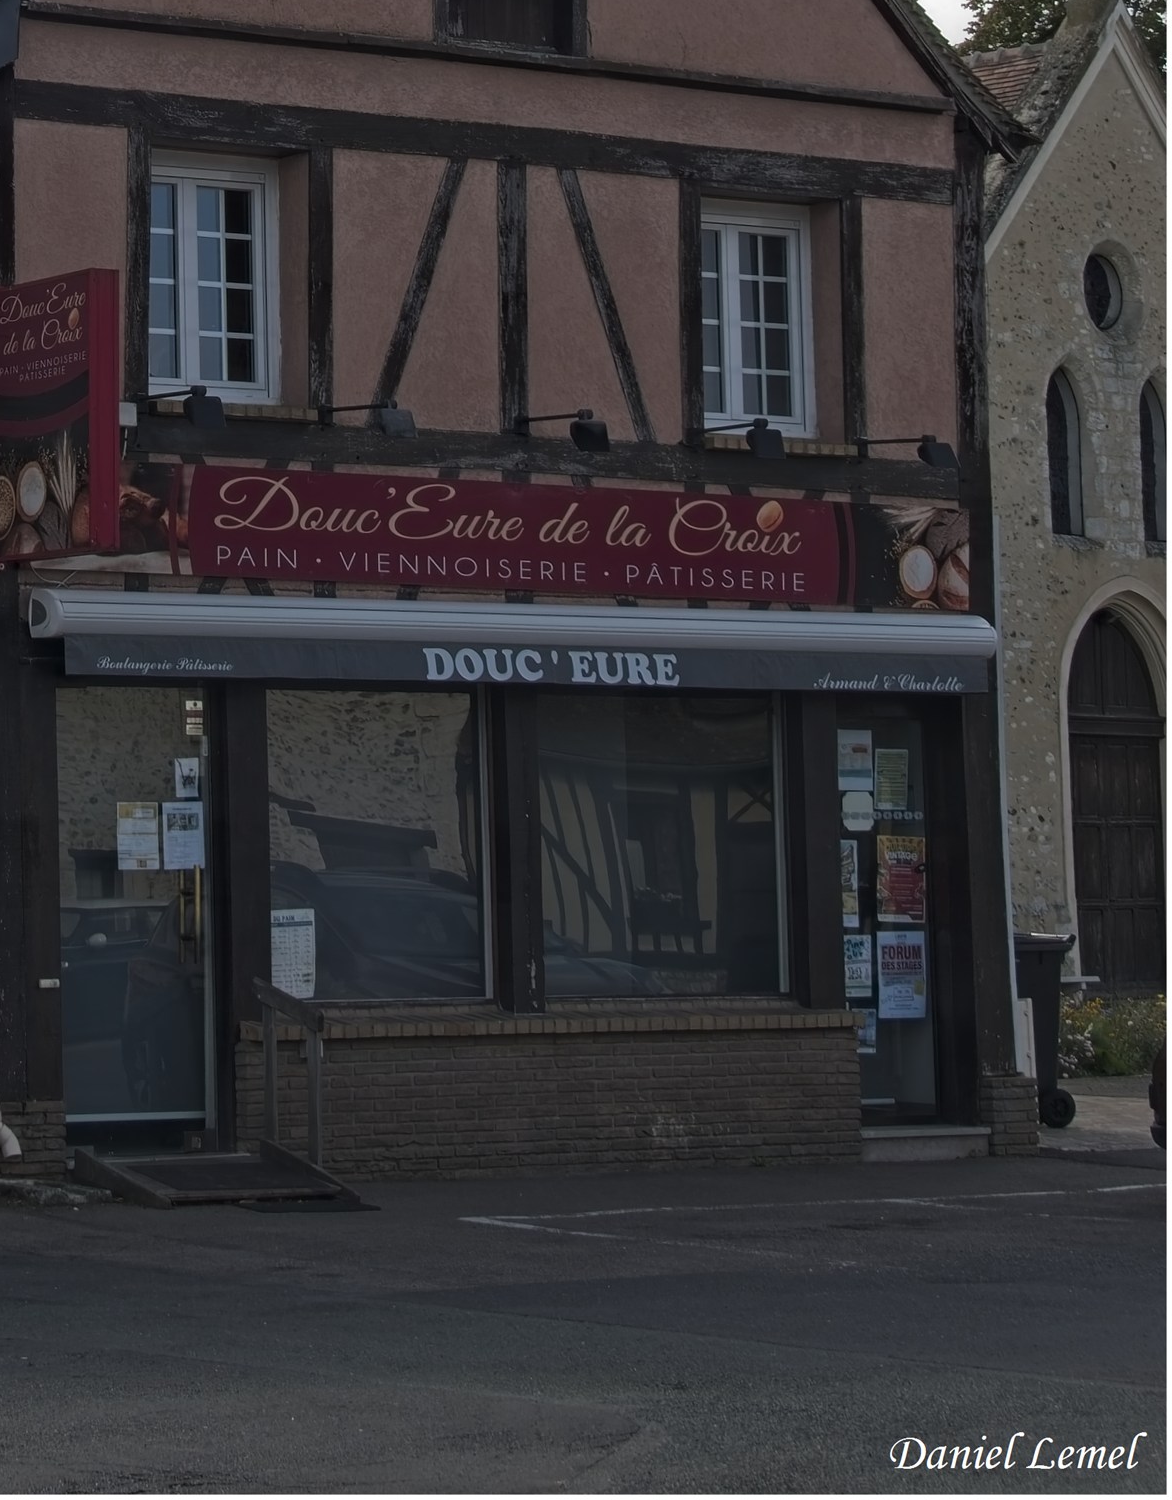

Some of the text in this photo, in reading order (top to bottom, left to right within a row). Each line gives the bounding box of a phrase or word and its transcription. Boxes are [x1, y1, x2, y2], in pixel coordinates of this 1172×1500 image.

[3, 319, 83, 355] de la Croix
[0, 350, 87, 377] PAIN VIENNOISERIE
[213, 476, 802, 556] Douc'Eure de la Croix
[216, 545, 805, 592] PAIN VIENNOISERIE PÂTISSERIE
[96, 655, 234, 675] Boulangerie Pâtisserie
[813, 672, 965, 691] Armand & Charlotte
[881, 945, 922, 960] FORUM
[881, 961, 923, 970] DES STAGES
